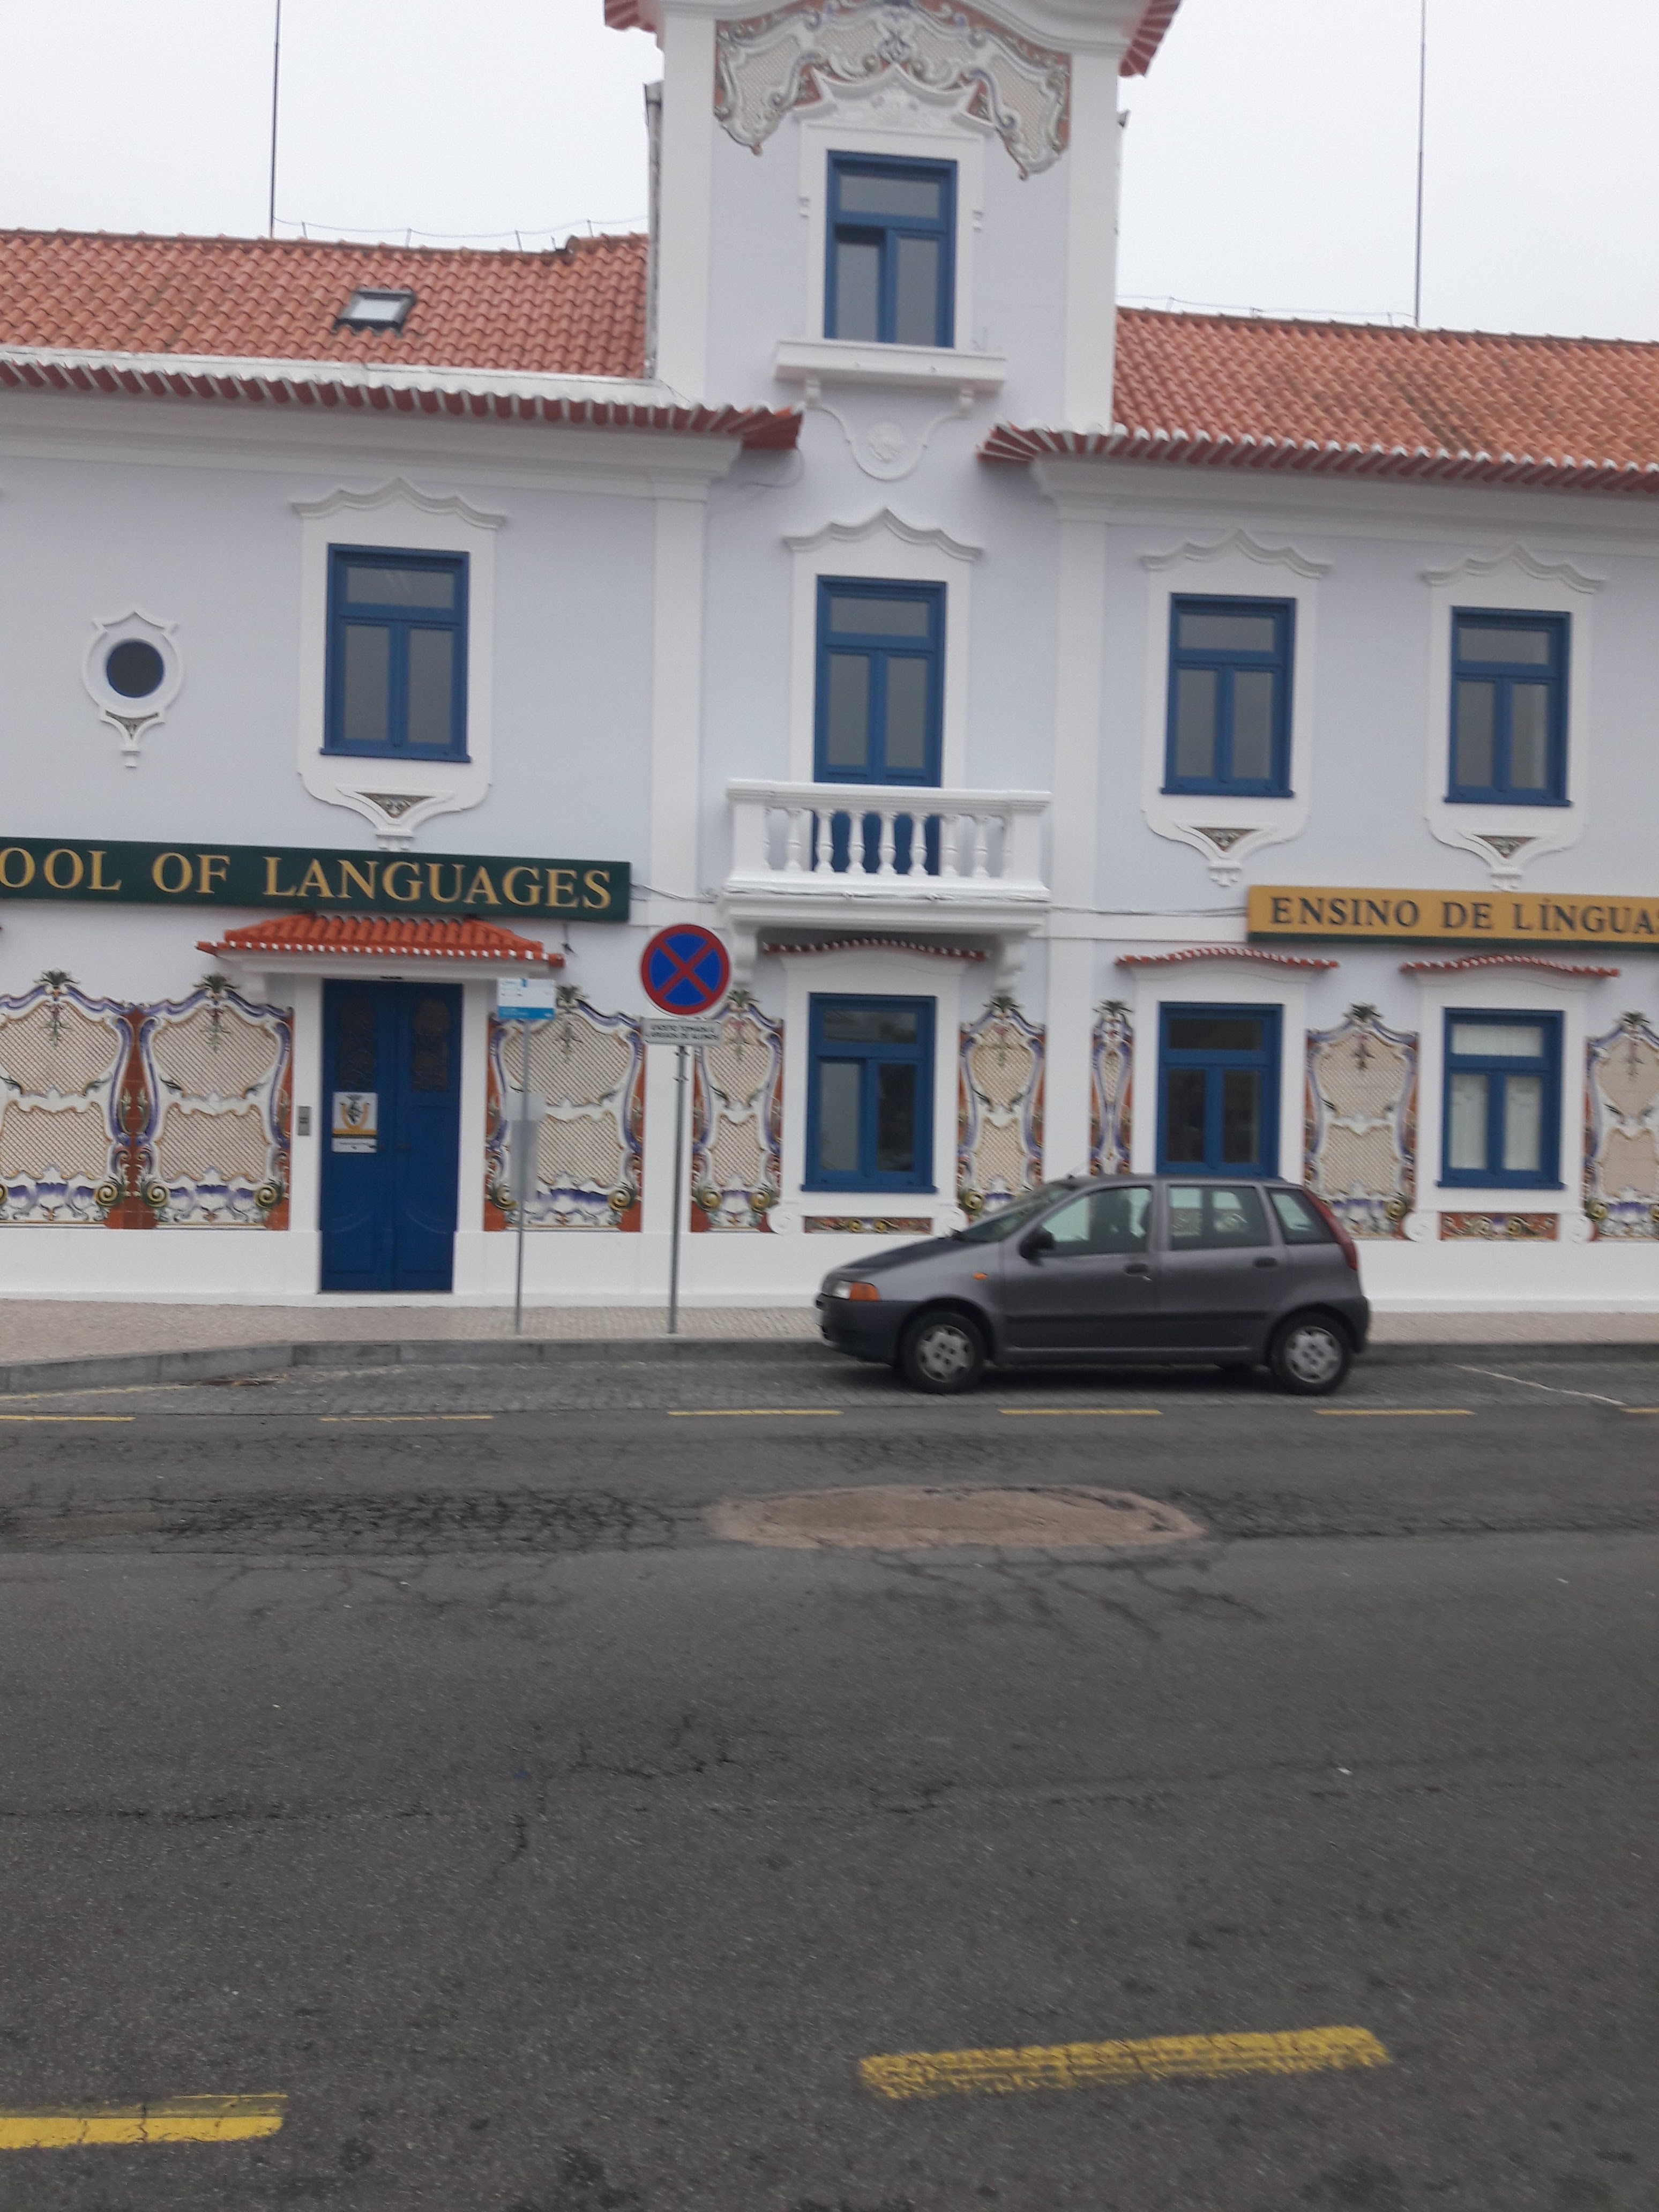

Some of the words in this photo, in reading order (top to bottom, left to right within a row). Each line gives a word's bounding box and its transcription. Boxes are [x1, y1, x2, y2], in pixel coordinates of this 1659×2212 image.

[151, 851, 230, 894] OF
[263, 857, 612, 910] LANGUAGES
[1270, 896, 1420, 927] ENSINO
[1441, 901, 1492, 930] DE
[1511, 897, 1659, 935] LÍNGUA
